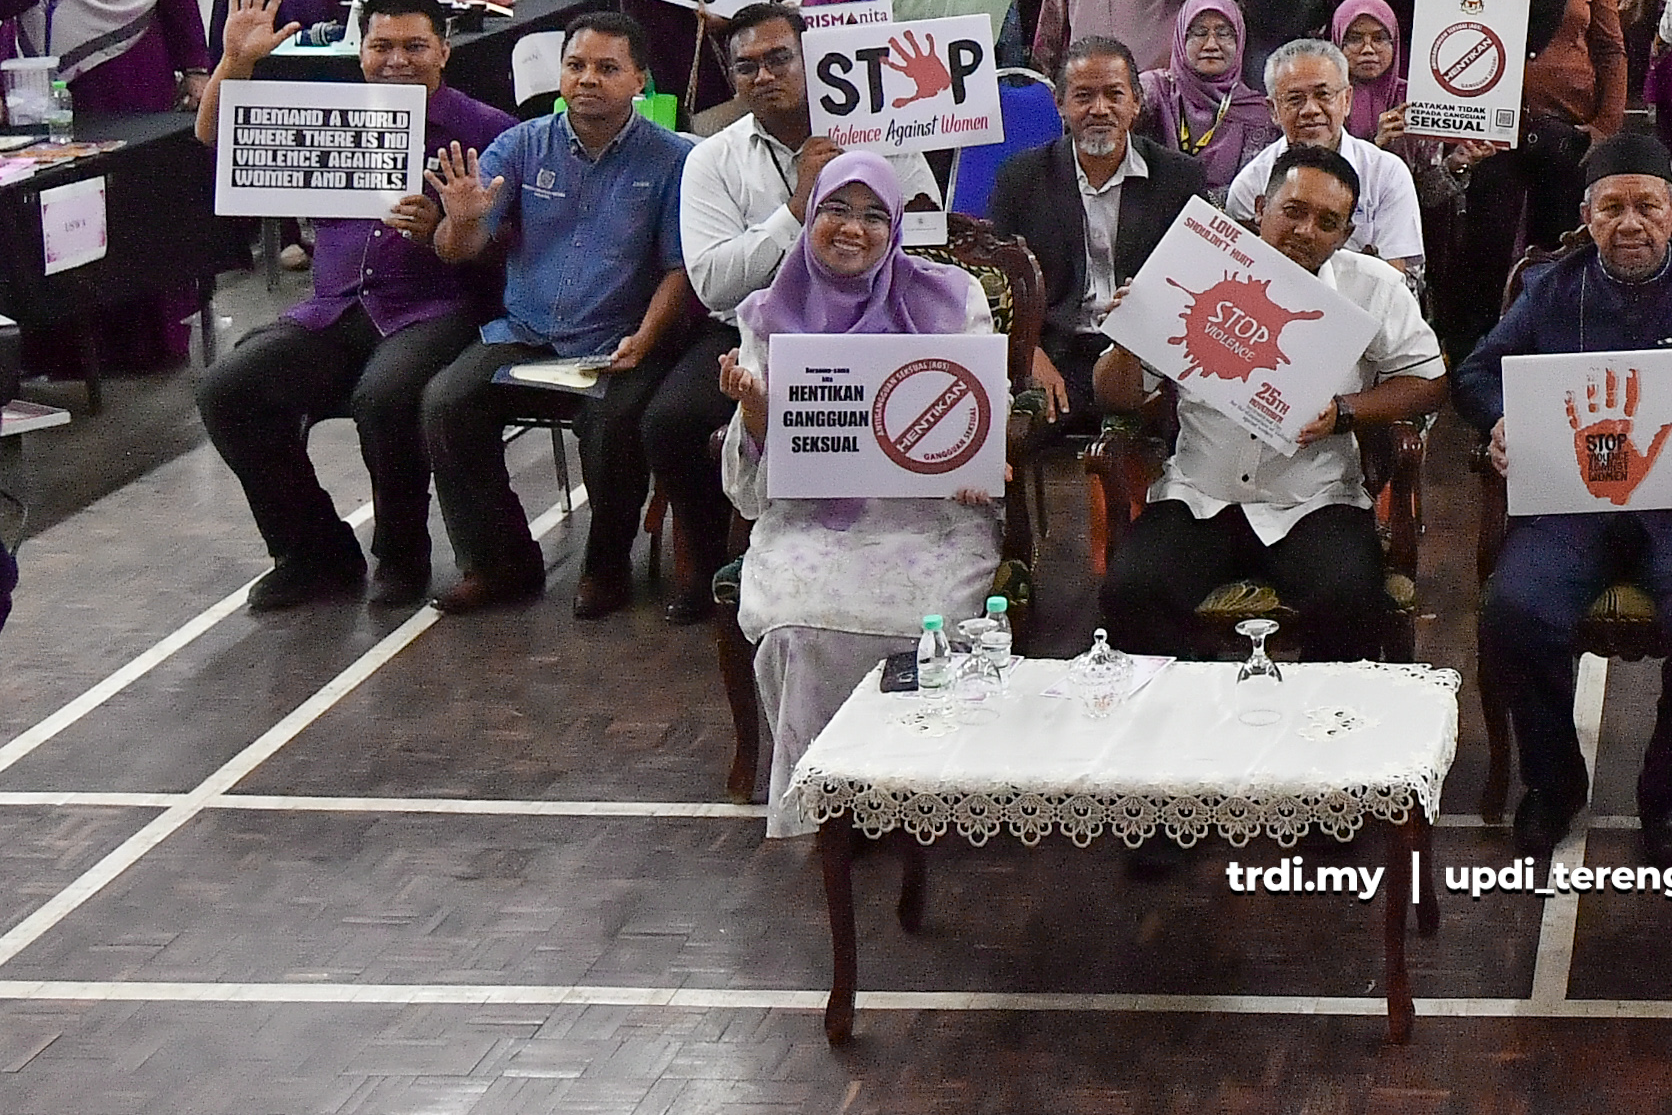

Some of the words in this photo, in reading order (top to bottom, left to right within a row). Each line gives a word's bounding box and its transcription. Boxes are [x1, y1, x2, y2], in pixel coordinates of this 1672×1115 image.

[1443, 36, 1494, 83] HENTIKAN
[1410, 109, 1442, 117] KEPADA
[1443, 112, 1486, 120] GANGGUAN
[1411, 101, 1455, 111] KATAKAN
[1457, 105, 1486, 114] TIDAK
[237, 108, 244, 124] I
[250, 108, 324, 126] DEMAND
[329, 110, 341, 127] A
[347, 111, 409, 128] WORLD
[1410, 115, 1485, 132] SEKSUAL
[236, 128, 297, 146] WHERE
[303, 130, 355, 147] THERE
[361, 131, 379, 148] IS
[384, 132, 407, 149] NO
[828, 124, 881, 147] Violence
[885, 115, 938, 147] Against
[941, 114, 989, 134] Women
[236, 149, 321, 167] VIOLENCE
[328, 151, 406, 169] AGAINST
[234, 169, 304, 187] WOMEN
[311, 171, 346, 188] AND
[353, 172, 407, 189] GIRLS.
[1208, 215, 1242, 244] LOVE
[1183, 216, 1230, 253] SHOULDN'T
[1229, 246, 1255, 269] HURT
[1207, 301, 1269, 346] STOP
[1203, 322, 1255, 363] VIOLENCE
[895, 361, 928, 381] SEKSUAL
[788, 385, 864, 402] HENTIKAN
[1255, 382, 1291, 416] 25TH
[783, 411, 869, 428] GANGGUAN
[896, 380, 969, 454] HENTIKAN
[1249, 397, 1284, 424] NOVEMBER
[923, 439, 966, 462] GANGGUAN
[963, 406, 977, 443] SEKSUAL
[1585, 434, 1627, 452] STOP
[791, 436, 860, 454] SEKSUAL
[1588, 471, 1628, 482] WOMEN
